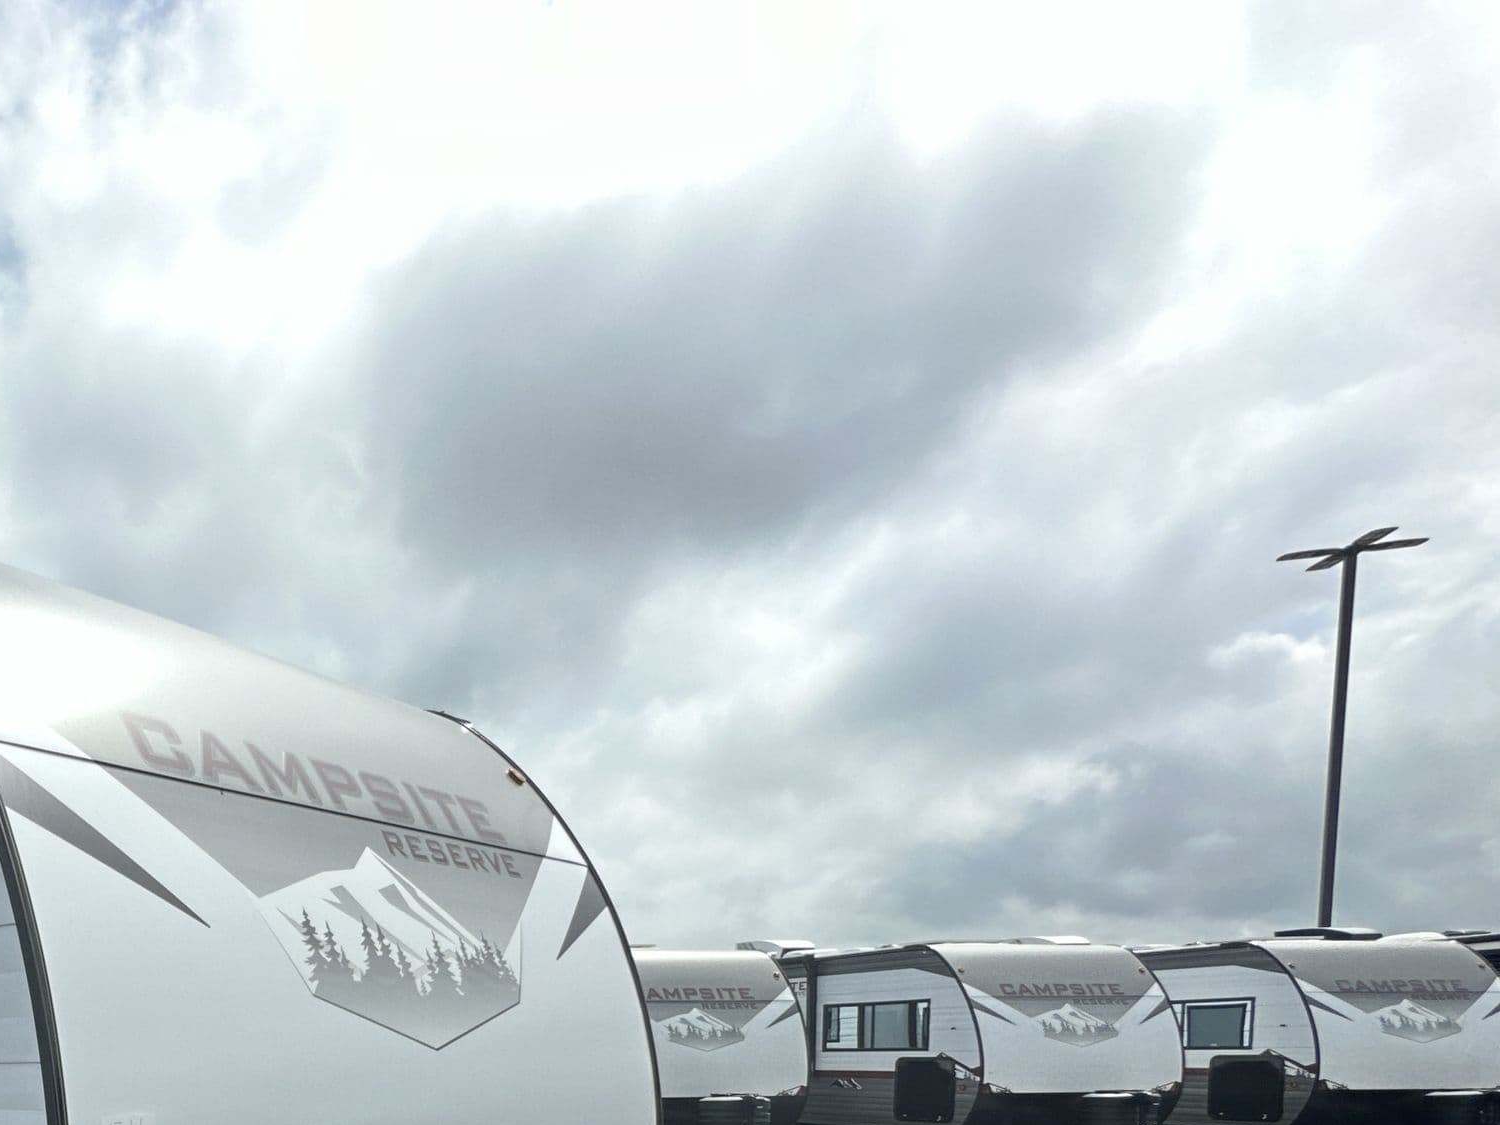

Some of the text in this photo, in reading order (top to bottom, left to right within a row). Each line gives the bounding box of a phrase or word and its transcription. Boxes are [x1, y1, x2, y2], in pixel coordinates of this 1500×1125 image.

[119, 711, 508, 845] CAMPSITE
[381, 829, 523, 879] RESERVE
[1000, 983, 1125, 996] CAMPSITE
[1334, 979, 1468, 992] CAMPSITE
[646, 987, 755, 1000] AMPSITE
